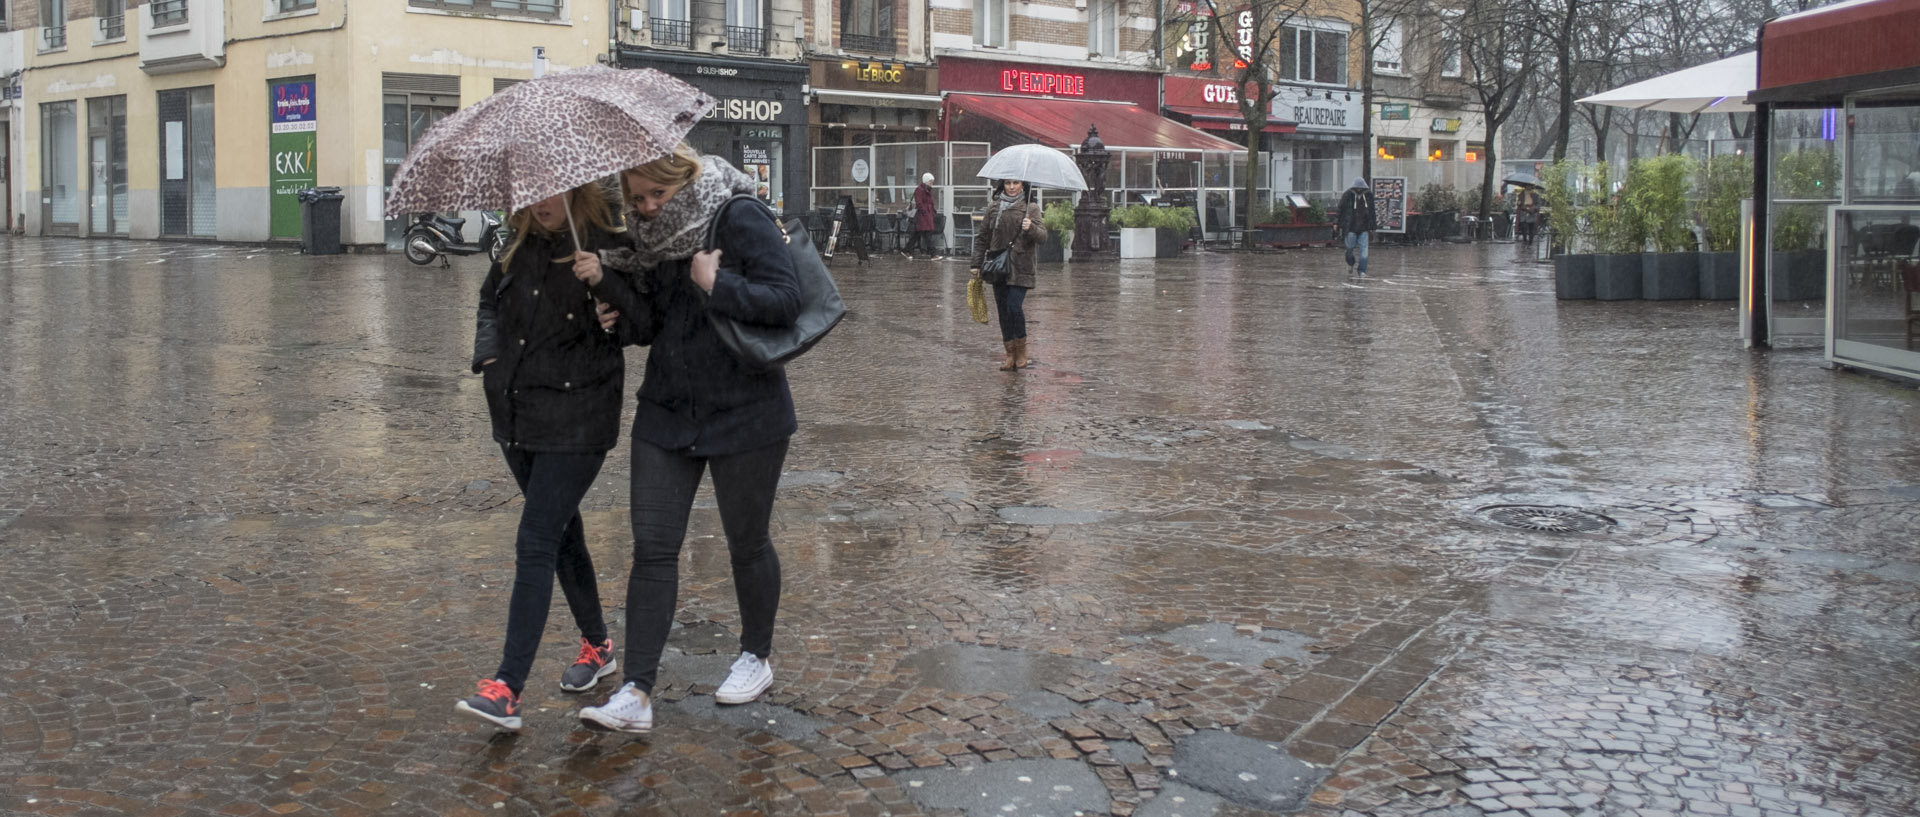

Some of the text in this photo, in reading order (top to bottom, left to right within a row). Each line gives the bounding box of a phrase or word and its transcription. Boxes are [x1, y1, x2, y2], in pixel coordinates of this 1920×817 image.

[857, 68, 902, 83] LE BROC
[1002, 69, 1085, 95] L'EMPIRE
[1295, 106, 1347, 127] BEAUREPAIRE
